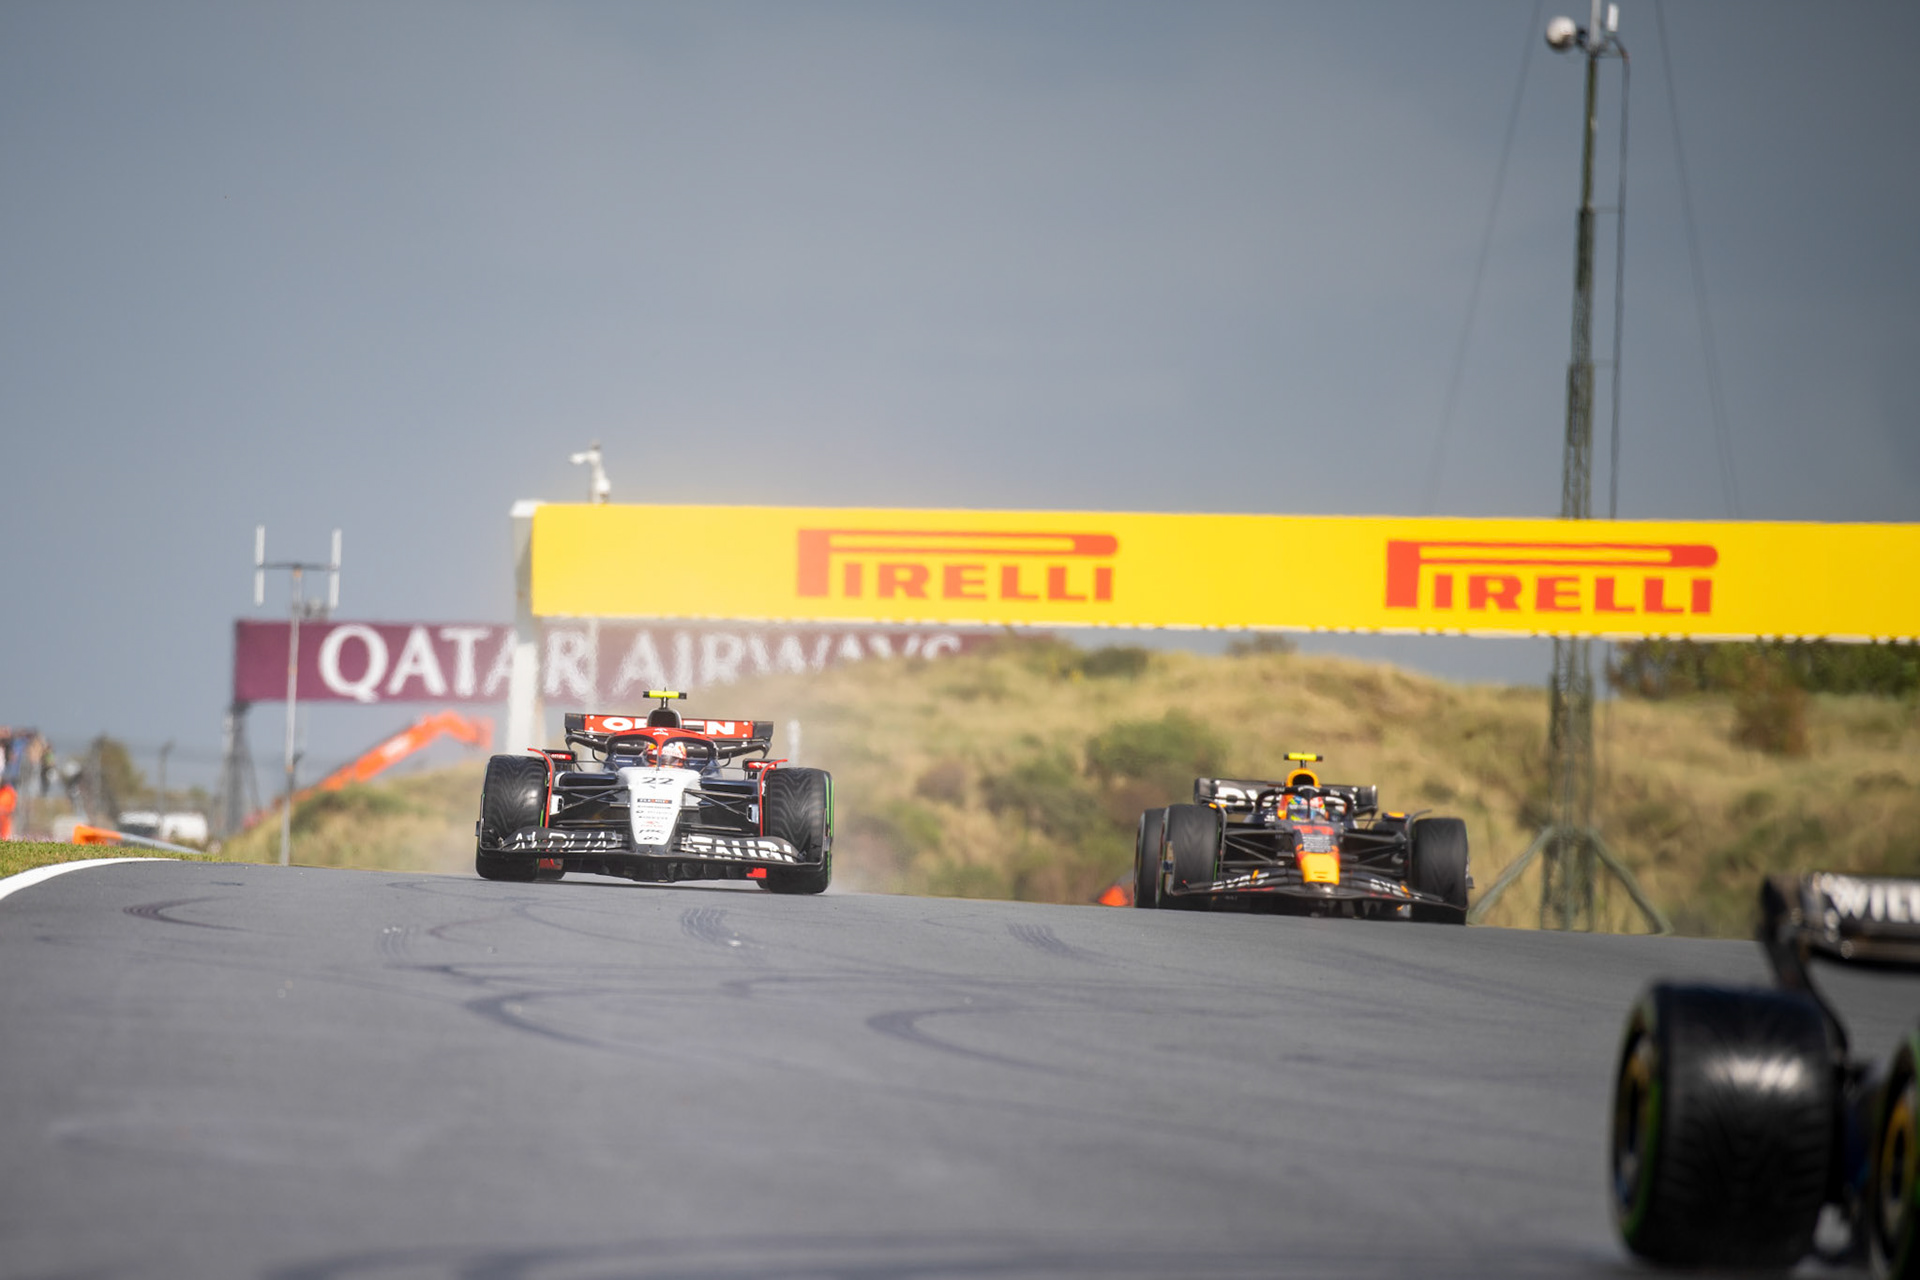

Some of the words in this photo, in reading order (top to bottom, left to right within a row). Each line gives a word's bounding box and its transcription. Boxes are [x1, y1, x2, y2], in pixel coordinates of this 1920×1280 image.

[797, 529, 1118, 602] PIRELLI
[1384, 539, 1719, 614] PIRELLI
[641, 777, 674, 785] 22
